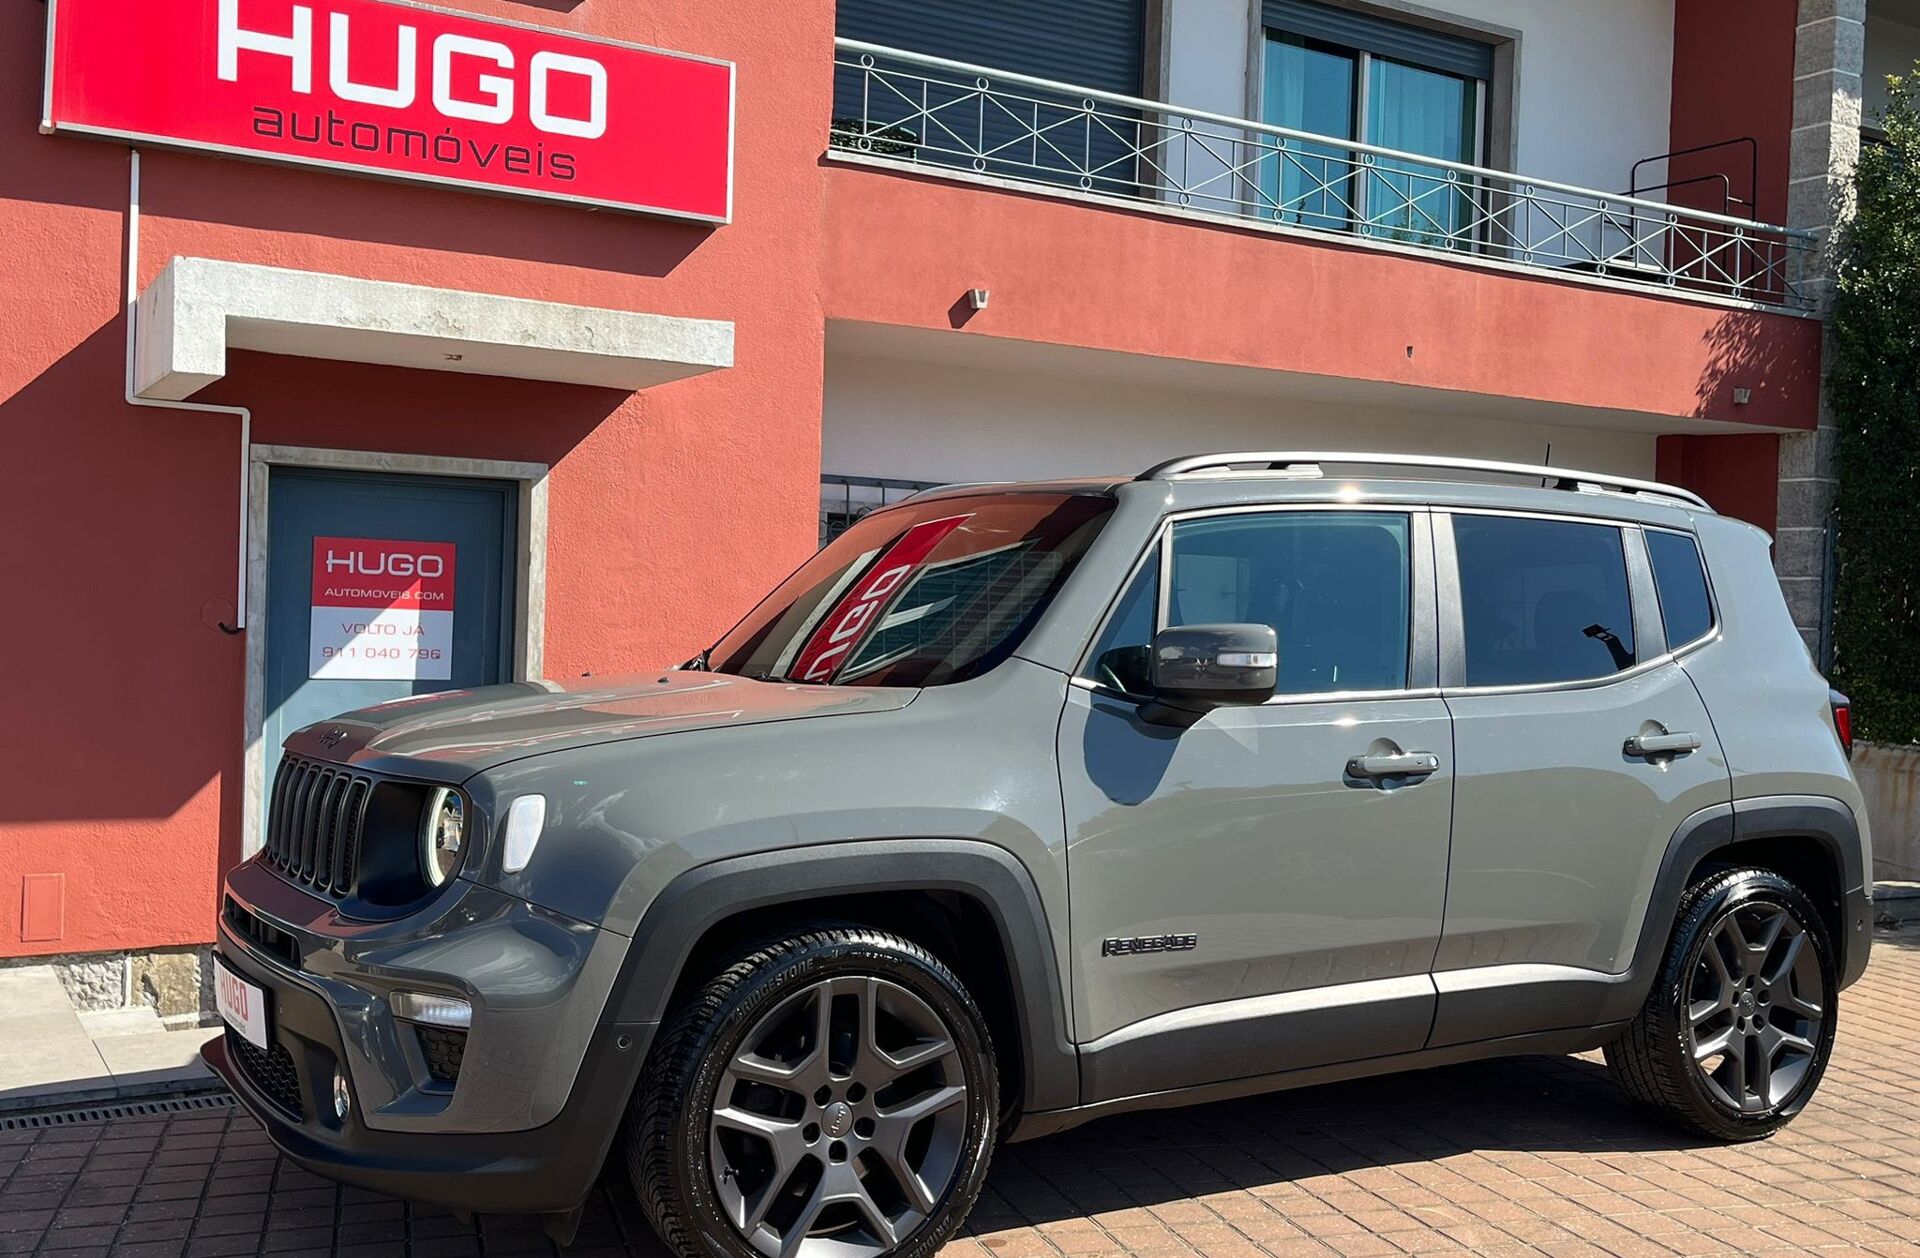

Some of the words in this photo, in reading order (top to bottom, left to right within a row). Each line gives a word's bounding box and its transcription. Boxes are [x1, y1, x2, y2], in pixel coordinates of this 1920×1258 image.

[217, 0, 608, 140] HUGO
[253, 106, 576, 180] automóveis
[325, 549, 443, 578] HUGO
[341, 623, 396, 636] VOLTO
[402, 622, 425, 636] JÁ
[322, 646, 356, 658] 911
[365, 647, 400, 659] 040
[408, 648, 442, 660] 796
[1102, 933, 1197, 957] RENEGADE
[218, 966, 249, 1022] HUGO
[733, 957, 815, 1022] BRIDGESTONE
